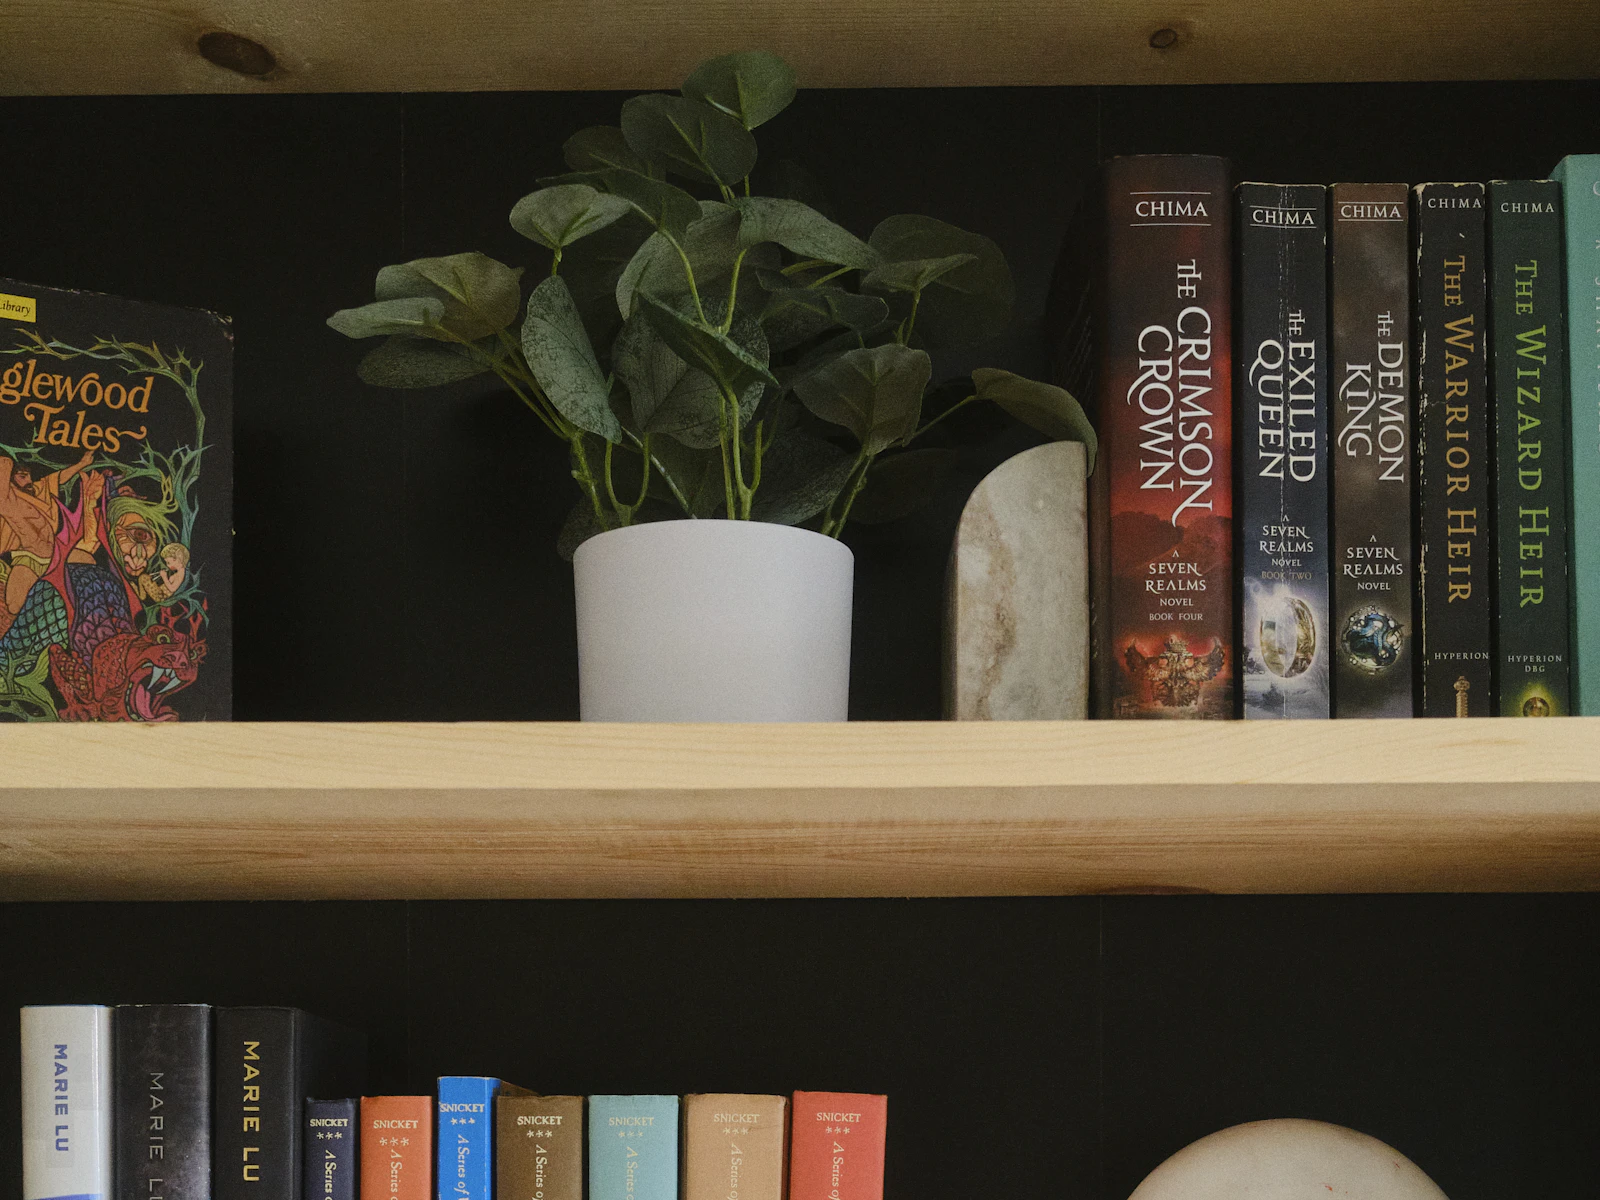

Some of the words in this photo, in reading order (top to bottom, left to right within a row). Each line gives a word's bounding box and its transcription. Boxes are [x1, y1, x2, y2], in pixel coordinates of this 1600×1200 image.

[1135, 200, 1208, 217] CHIMA
[1340, 204, 1401, 218] CHIMA
[1427, 198, 1482, 209] CHIMA
[1500, 202, 1554, 213] CHIMA
[1252, 209, 1315, 225] CHIMA
[1177, 259, 1202, 299] THE
[1443, 255, 1466, 307] THE
[1514, 259, 1538, 315] THE
[1288, 309, 1305, 336] THE
[1377, 310, 1394, 337] THE
[1127, 324, 1175, 492] CROWN
[1249, 339, 1286, 480] QUEEN
[1288, 339, 1316, 483] EXILED
[1337, 361, 1377, 458] KING
[1377, 341, 1404, 483] DEMON
[1444, 314, 1474, 496] WARRIOR
[1515, 325, 1546, 491] WIZARD
[1171, 306, 1214, 527] CRIMSON
[24, 403, 147, 453] Tales
[1262, 525, 1310, 539] SEVEN
[1259, 541, 1314, 555] REALMS
[1346, 547, 1399, 561] SEVEN
[1447, 507, 1477, 604] HEIR
[1271, 558, 1302, 567] NOVEL
[1518, 505, 1549, 608] HEIR
[1149, 562, 1203, 576] SEVEN
[1261, 571, 1286, 580] BOOK
[1289, 571, 1312, 580] TWO
[1343, 563, 1403, 578] REALMS
[1145, 579, 1207, 594] REALMS
[1357, 582, 1391, 591] NOVEL
[1159, 598, 1194, 607] NOVEL
[1149, 612, 1174, 621] BOOK
[1178, 612, 1203, 621] FOUR
[1434, 652, 1489, 660] HYPERION
[1507, 655, 1562, 663] HYPERION
[1524, 665, 1546, 673] DBG
[54, 1044, 69, 1116] MARIE
[243, 1041, 260, 1132] MARIE
[149, 1071, 164, 1160] MARIE
[440, 1103, 485, 1113] SNICKET
[309, 1118, 349, 1127] SNICKET
[373, 1120, 418, 1129] SNICKET
[517, 1116, 563, 1125] SNICKET
[608, 1117, 654, 1126] SNICKET
[713, 1113, 760, 1123] SNICKET
[816, 1112, 862, 1122] SNICKET
[55, 1125, 69, 1152] LU
[325, 1150, 337, 1159] A
[535, 1144, 547, 1154] A
[833, 1141, 845, 1154] A
[243, 1147, 260, 1182] LU
[535, 1156, 547, 1188] Series
[832, 1156, 844, 1187] Series
[325, 1162, 337, 1194] Series
